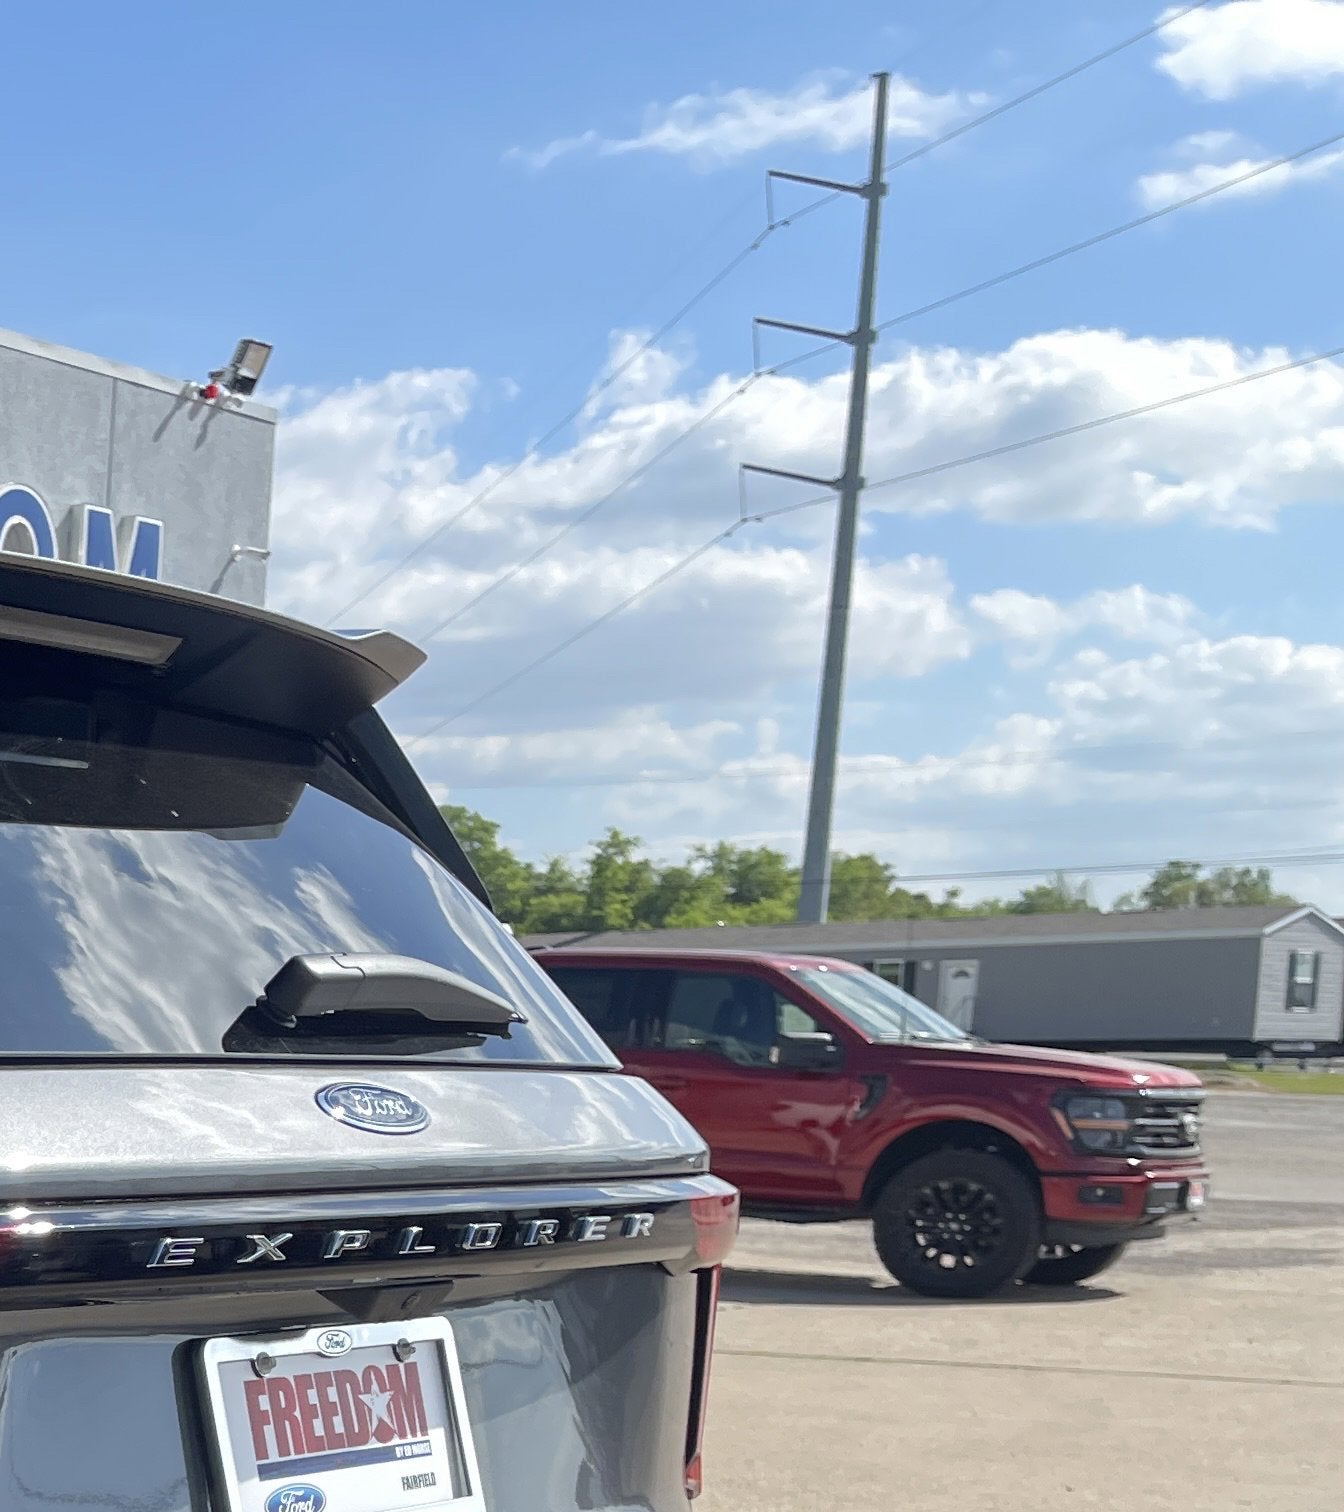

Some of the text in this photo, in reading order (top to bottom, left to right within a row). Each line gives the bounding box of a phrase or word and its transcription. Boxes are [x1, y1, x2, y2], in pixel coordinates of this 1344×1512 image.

[146, 1212, 657, 1268] EXPLORER
[243, 1362, 429, 1461] FREEDOM
[401, 1471, 437, 1491] FAIRFIELD
